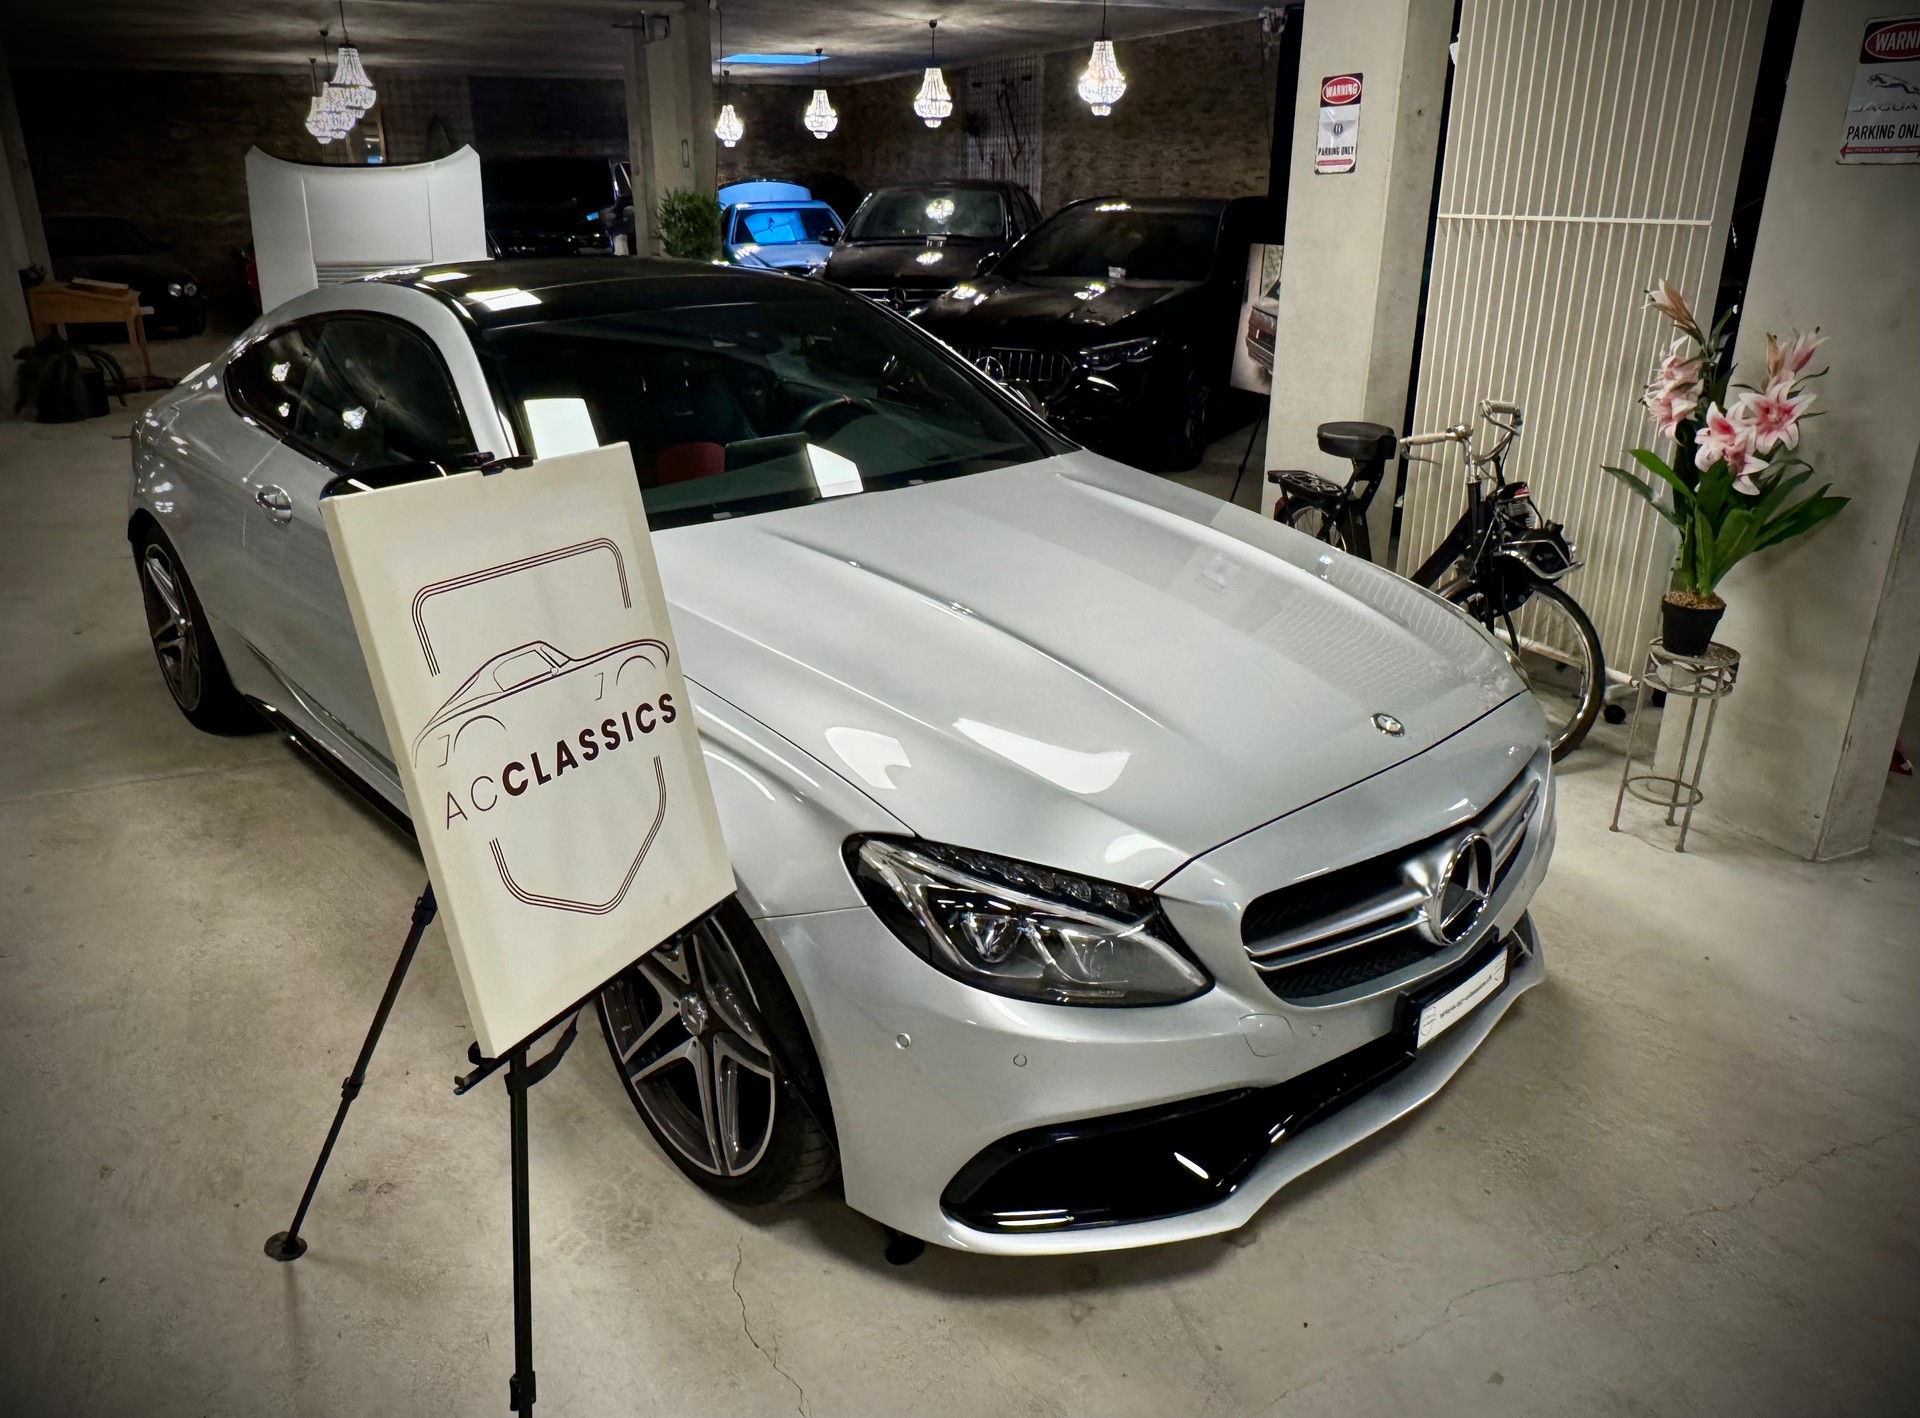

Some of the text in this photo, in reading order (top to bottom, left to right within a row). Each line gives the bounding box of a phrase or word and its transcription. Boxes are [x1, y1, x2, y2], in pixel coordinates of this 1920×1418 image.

[1325, 83, 1358, 98] WARNING
[1846, 123, 1920, 140] PARKING ONL
[1318, 146, 1354, 156] PARKING ONLY
